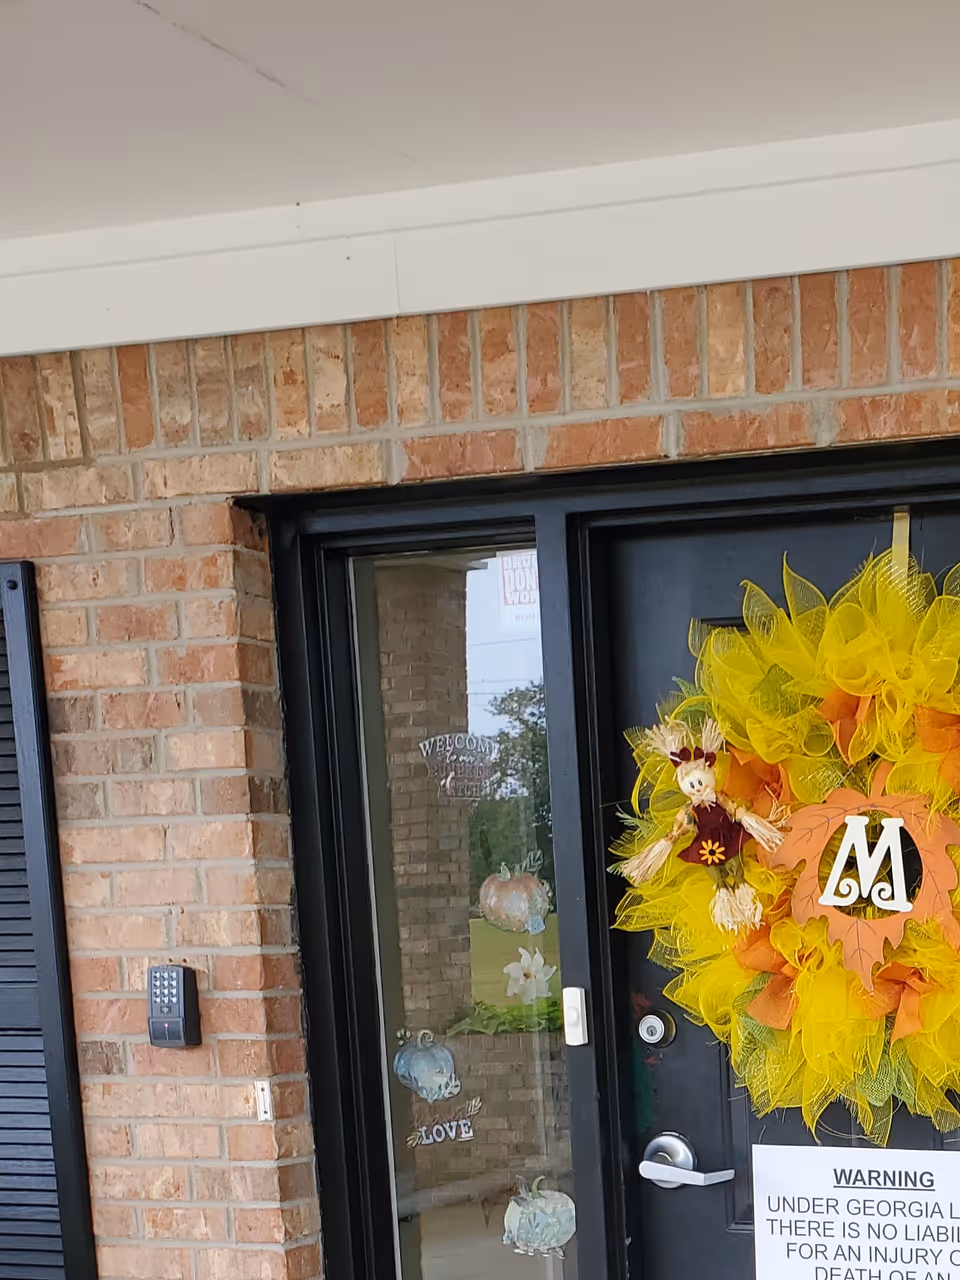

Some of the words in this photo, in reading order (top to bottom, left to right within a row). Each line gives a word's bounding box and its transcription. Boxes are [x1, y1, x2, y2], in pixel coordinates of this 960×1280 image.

[818, 815, 913, 912] M
[419, 1120, 475, 1145] LOVE
[833, 1168, 935, 1189] WARNING
[767, 1195, 839, 1215] UNDER
[846, 1198, 944, 1219] GEORGIA
[765, 1218, 835, 1237] THERE
[842, 1221, 860, 1238] IS
[867, 1222, 897, 1240] NO
[786, 1242, 828, 1260] FOR
[833, 1244, 860, 1261] AN
[869, 1245, 943, 1265] INJURY
